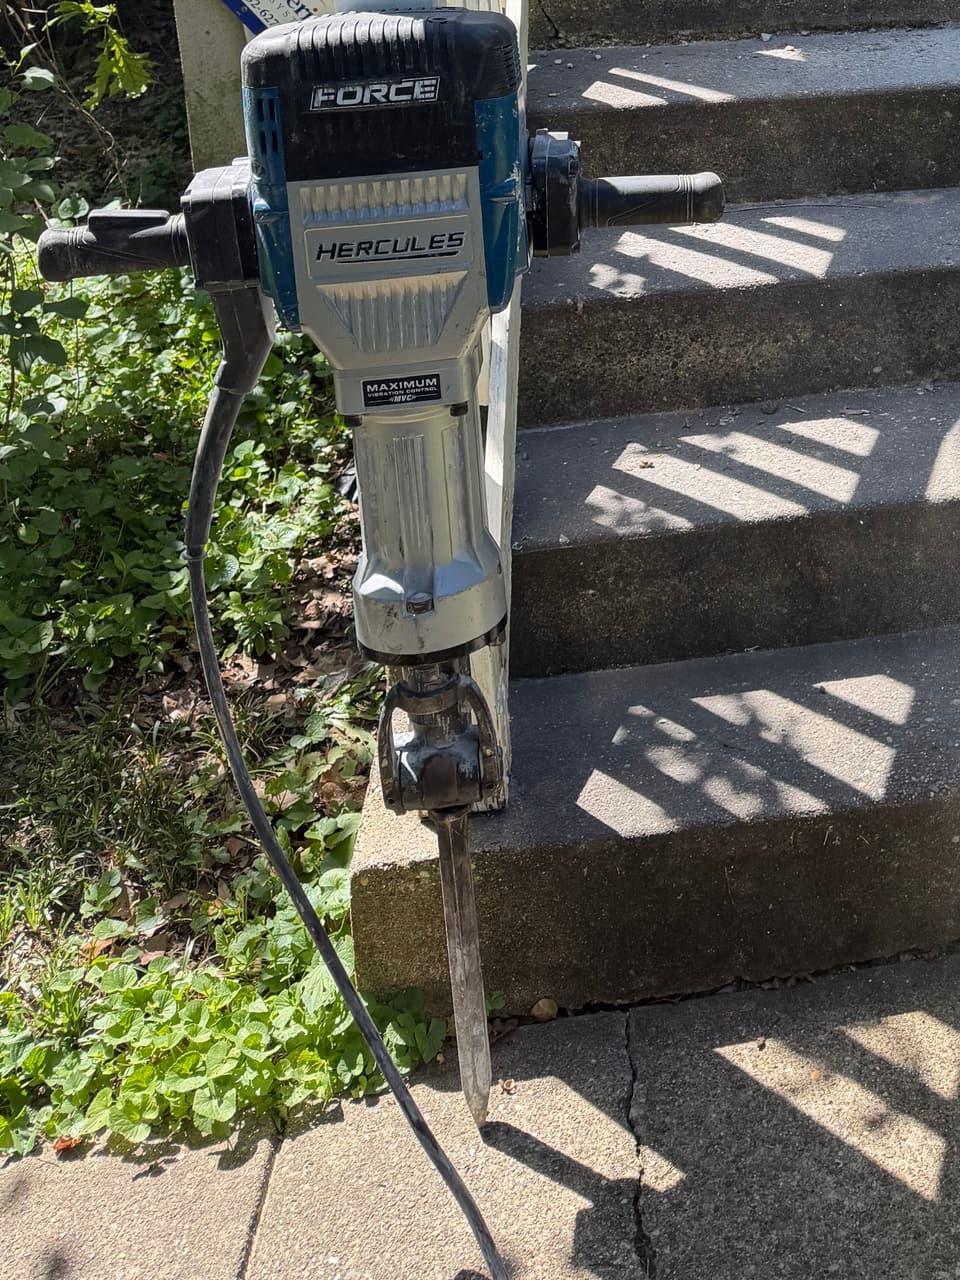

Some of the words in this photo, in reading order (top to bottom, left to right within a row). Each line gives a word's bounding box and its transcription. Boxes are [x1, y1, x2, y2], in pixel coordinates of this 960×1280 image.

[313, 79, 437, 107] FORCE
[316, 231, 465, 261] HERCULES
[366, 378, 437, 393] MAXIMUM
[367, 390, 404, 398] VIBRATION
[406, 386, 438, 394] CONTROL
